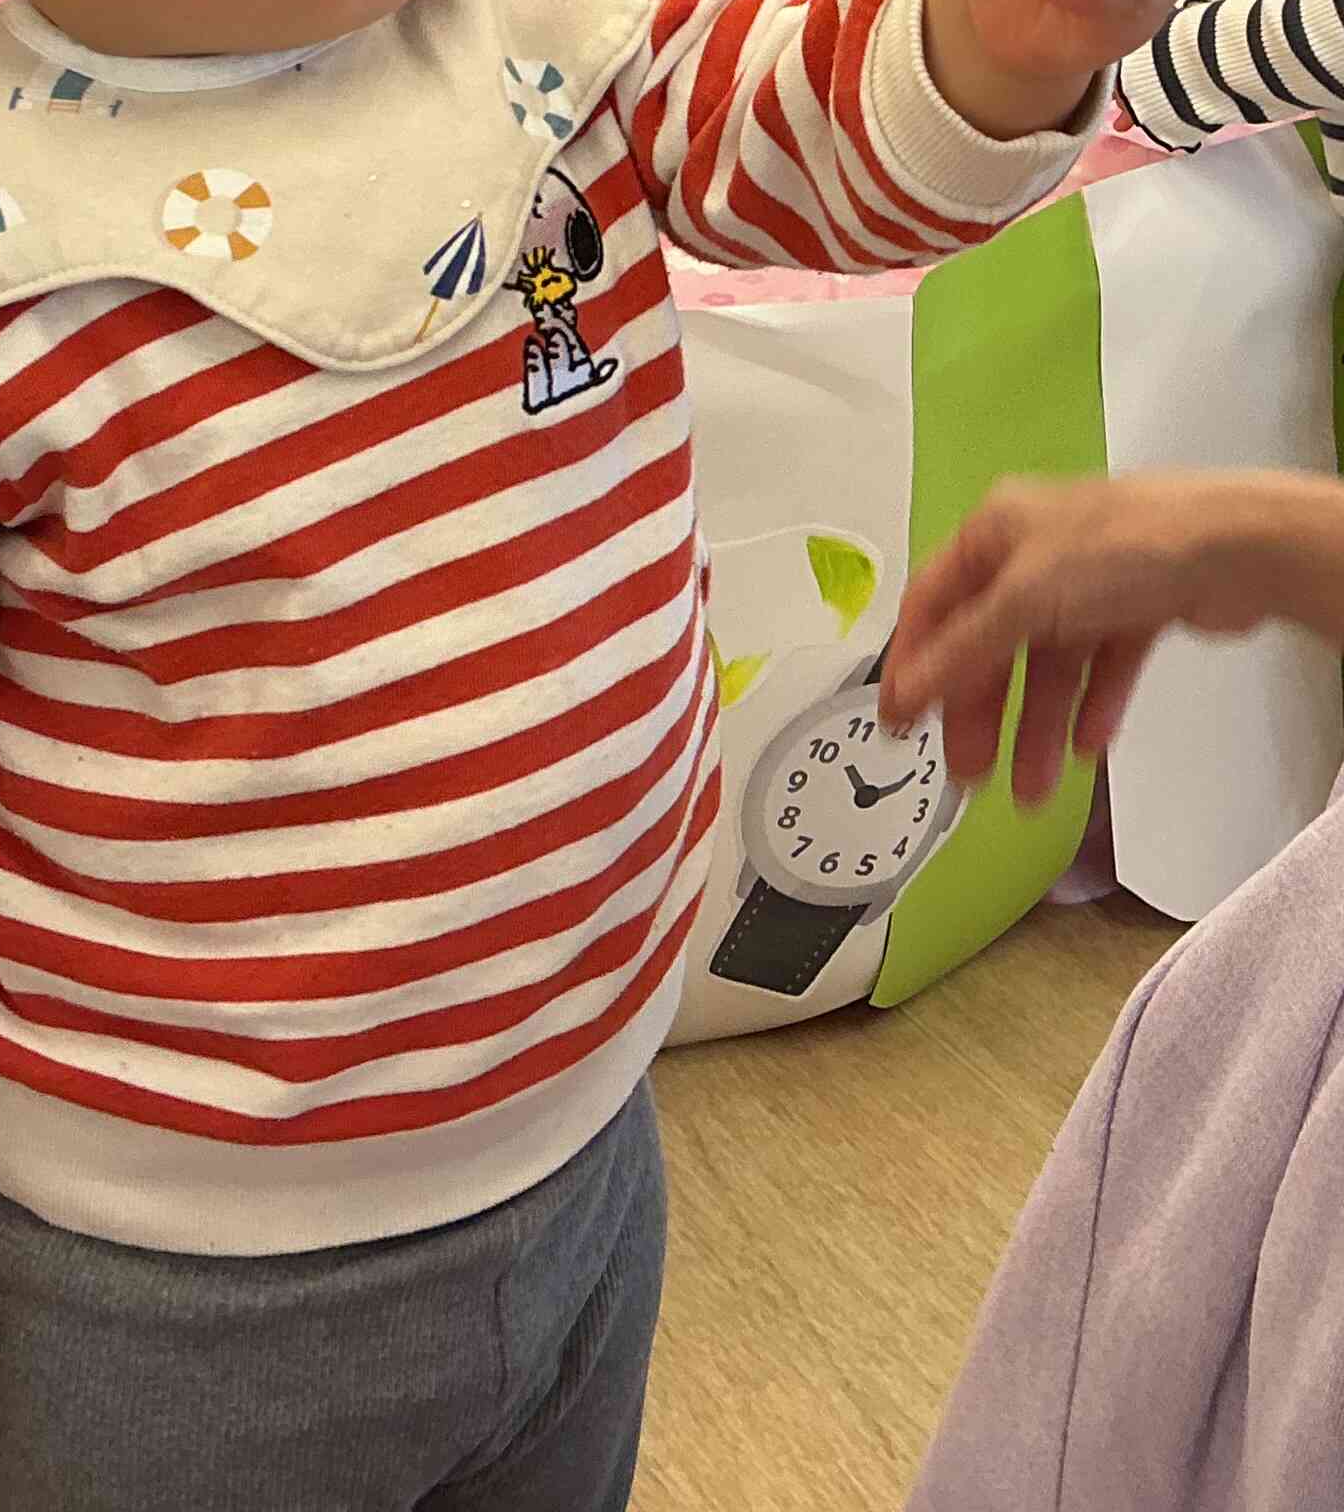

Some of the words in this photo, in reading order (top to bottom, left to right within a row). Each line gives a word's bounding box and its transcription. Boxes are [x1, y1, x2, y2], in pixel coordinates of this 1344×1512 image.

[848, 717, 876, 742] 11
[809, 738, 840, 763] 10
[917, 732, 929, 756] 1
[787, 770, 808, 793] 9
[920, 760, 936, 784] 2
[777, 805, 801, 829] 8
[912, 797, 929, 823] 3
[791, 835, 813, 858] 7
[891, 836, 909, 859] 4
[819, 852, 840, 874] 6
[854, 854, 877, 876] 5
